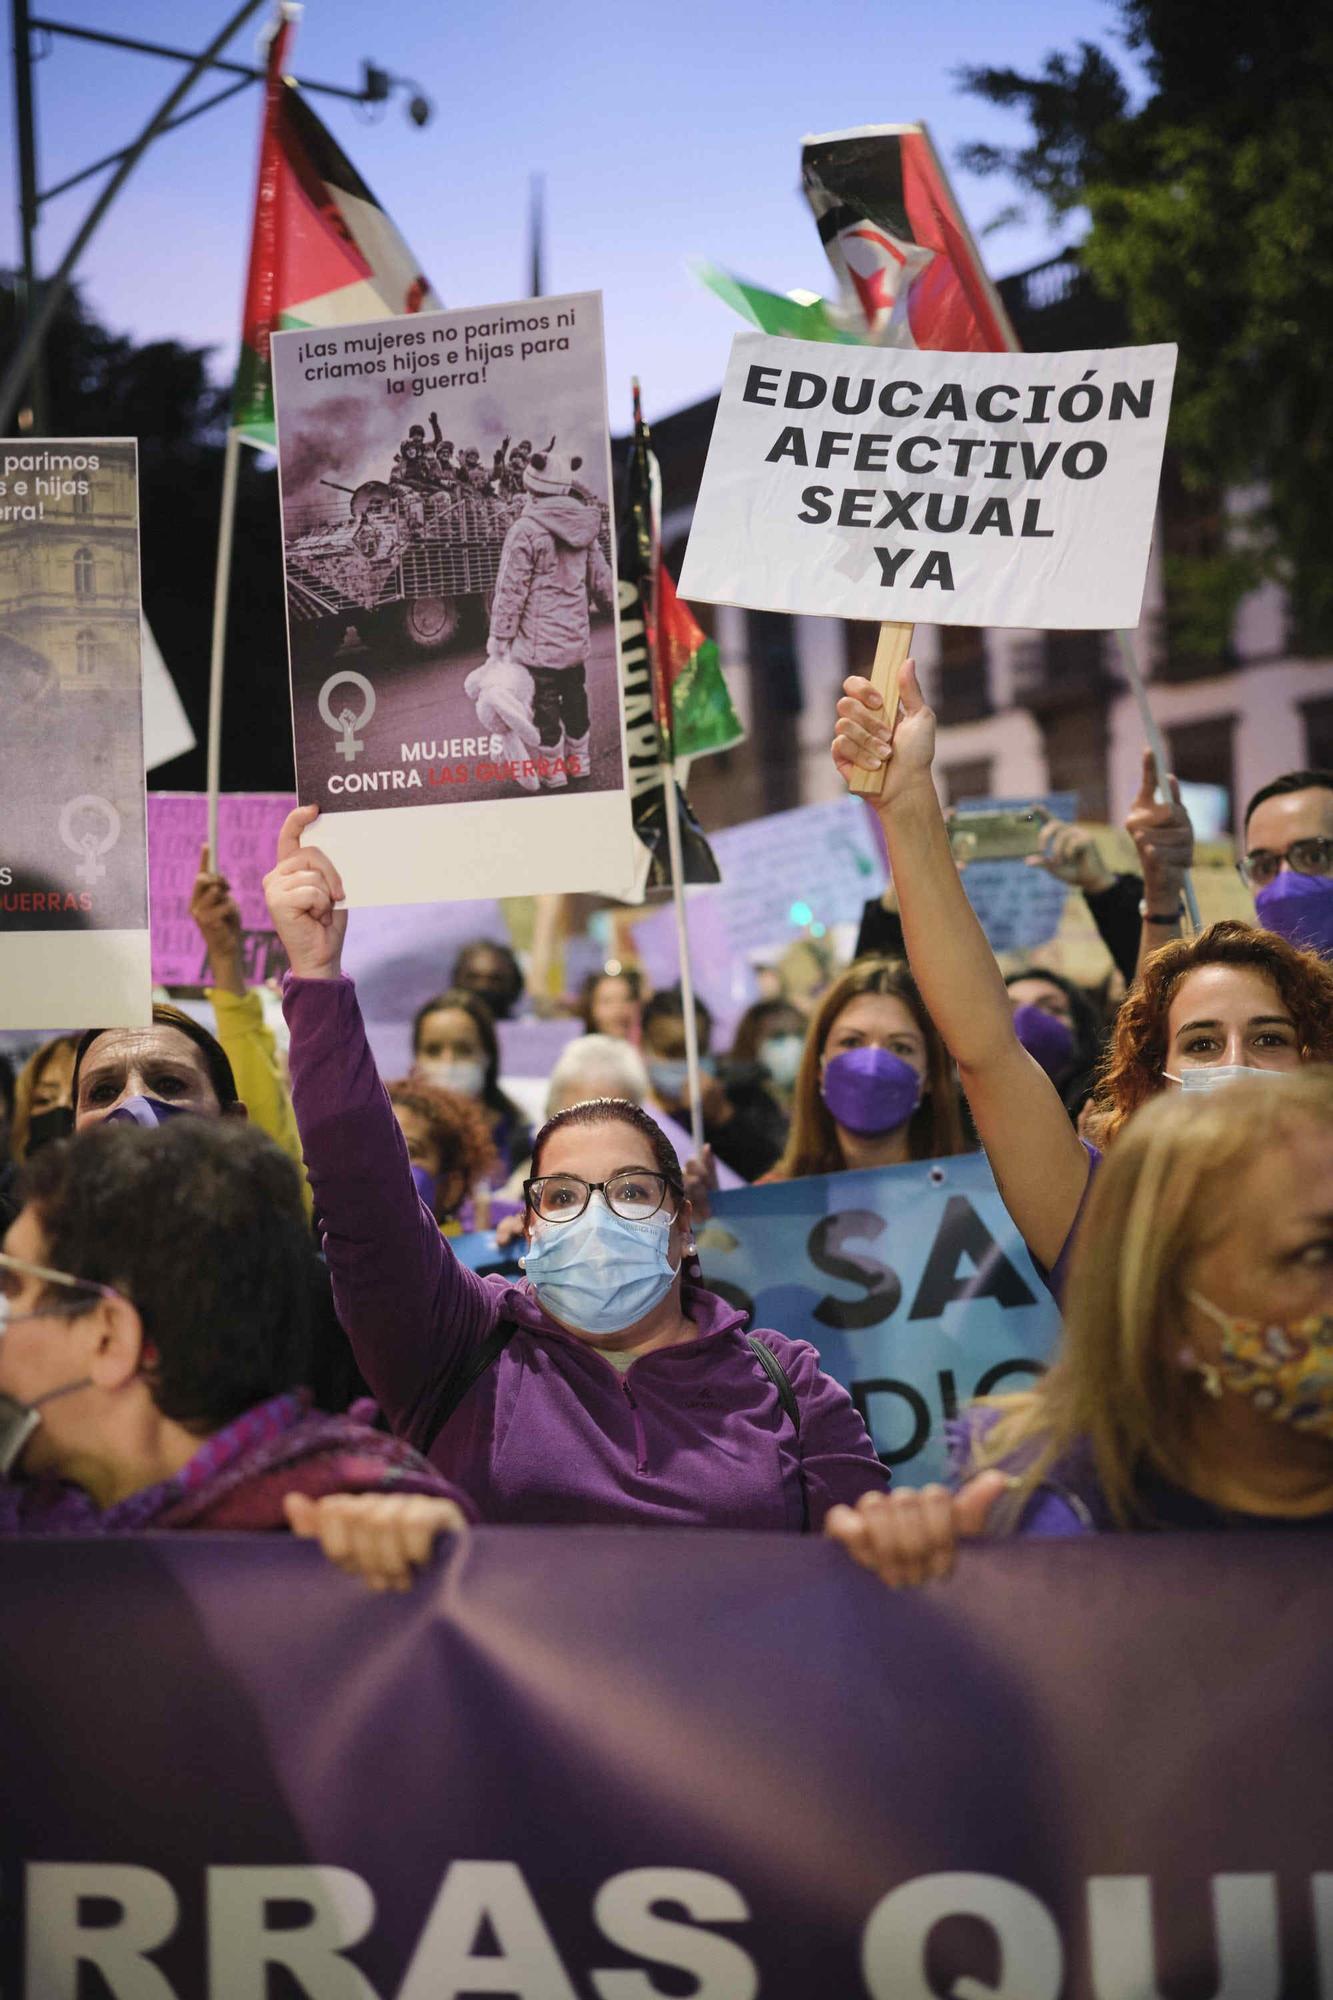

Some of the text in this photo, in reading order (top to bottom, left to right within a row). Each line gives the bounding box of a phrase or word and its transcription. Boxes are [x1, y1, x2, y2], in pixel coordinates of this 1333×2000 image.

[298, 309, 576, 363] ¡Las mujeres no parimos ni
[304, 336, 569, 381] criamos hijos e hijas para
[386, 367, 487, 397] la guerra!
[742, 364, 1155, 424] EDUCACIÓN
[4, 451, 100, 476] parimos
[764, 426, 1108, 481] AFECTIVO
[14, 480, 28, 495] e
[35, 476, 89, 501] hijas
[0, 502, 44, 520] rra!
[797, 485, 1055, 538] SEXUAL
[873, 546, 955, 591] YA
[401, 735, 503, 762] MUJERES
[327, 754, 581, 794] CONTRA LAS GUERRAS
[0, 891, 93, 912] UERRAS
